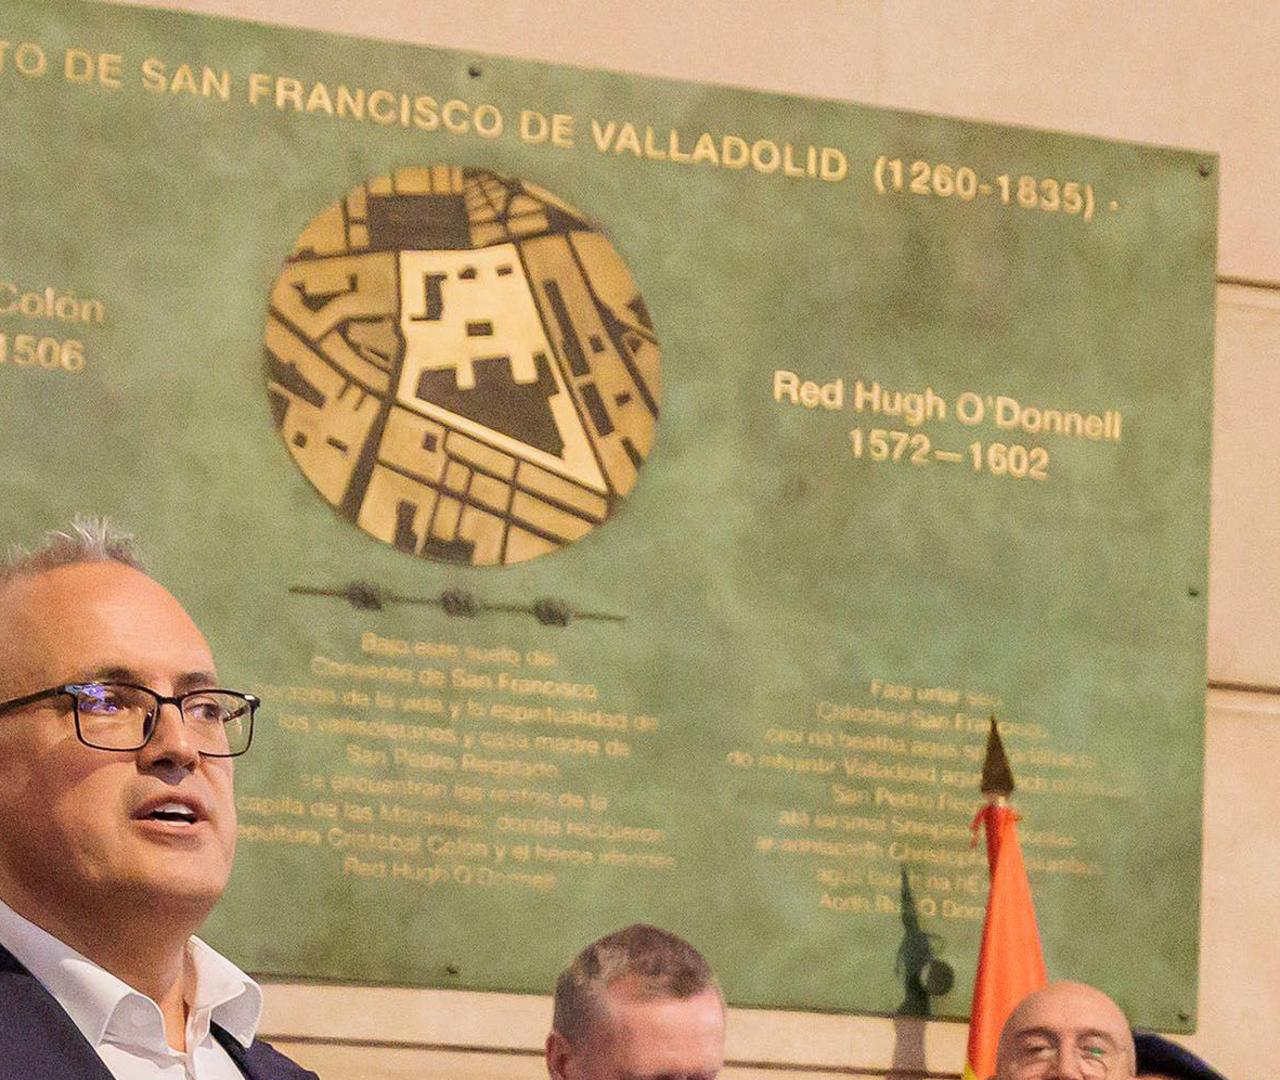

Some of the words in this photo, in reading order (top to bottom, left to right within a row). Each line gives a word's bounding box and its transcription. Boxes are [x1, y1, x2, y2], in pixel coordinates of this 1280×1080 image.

[64, 49, 122, 89] DE
[141, 60, 231, 101] SAN
[248, 74, 503, 138] FRANCISCO
[520, 110, 575, 149] DE
[590, 118, 849, 183] VALLADOLID
[873, 154, 1095, 222] (1260-1835)
[773, 369, 844, 411] Red
[855, 380, 947, 427] Hugh
[956, 391, 1122, 441] O'Donnell
[362, 632, 410, 657] Bajo
[415, 640, 459, 659] este
[310, 656, 415, 684] Convento
[419, 669, 447, 689] de
[451, 667, 493, 690] San
[498, 672, 598, 702] Francisco
[347, 744, 387, 768] San
